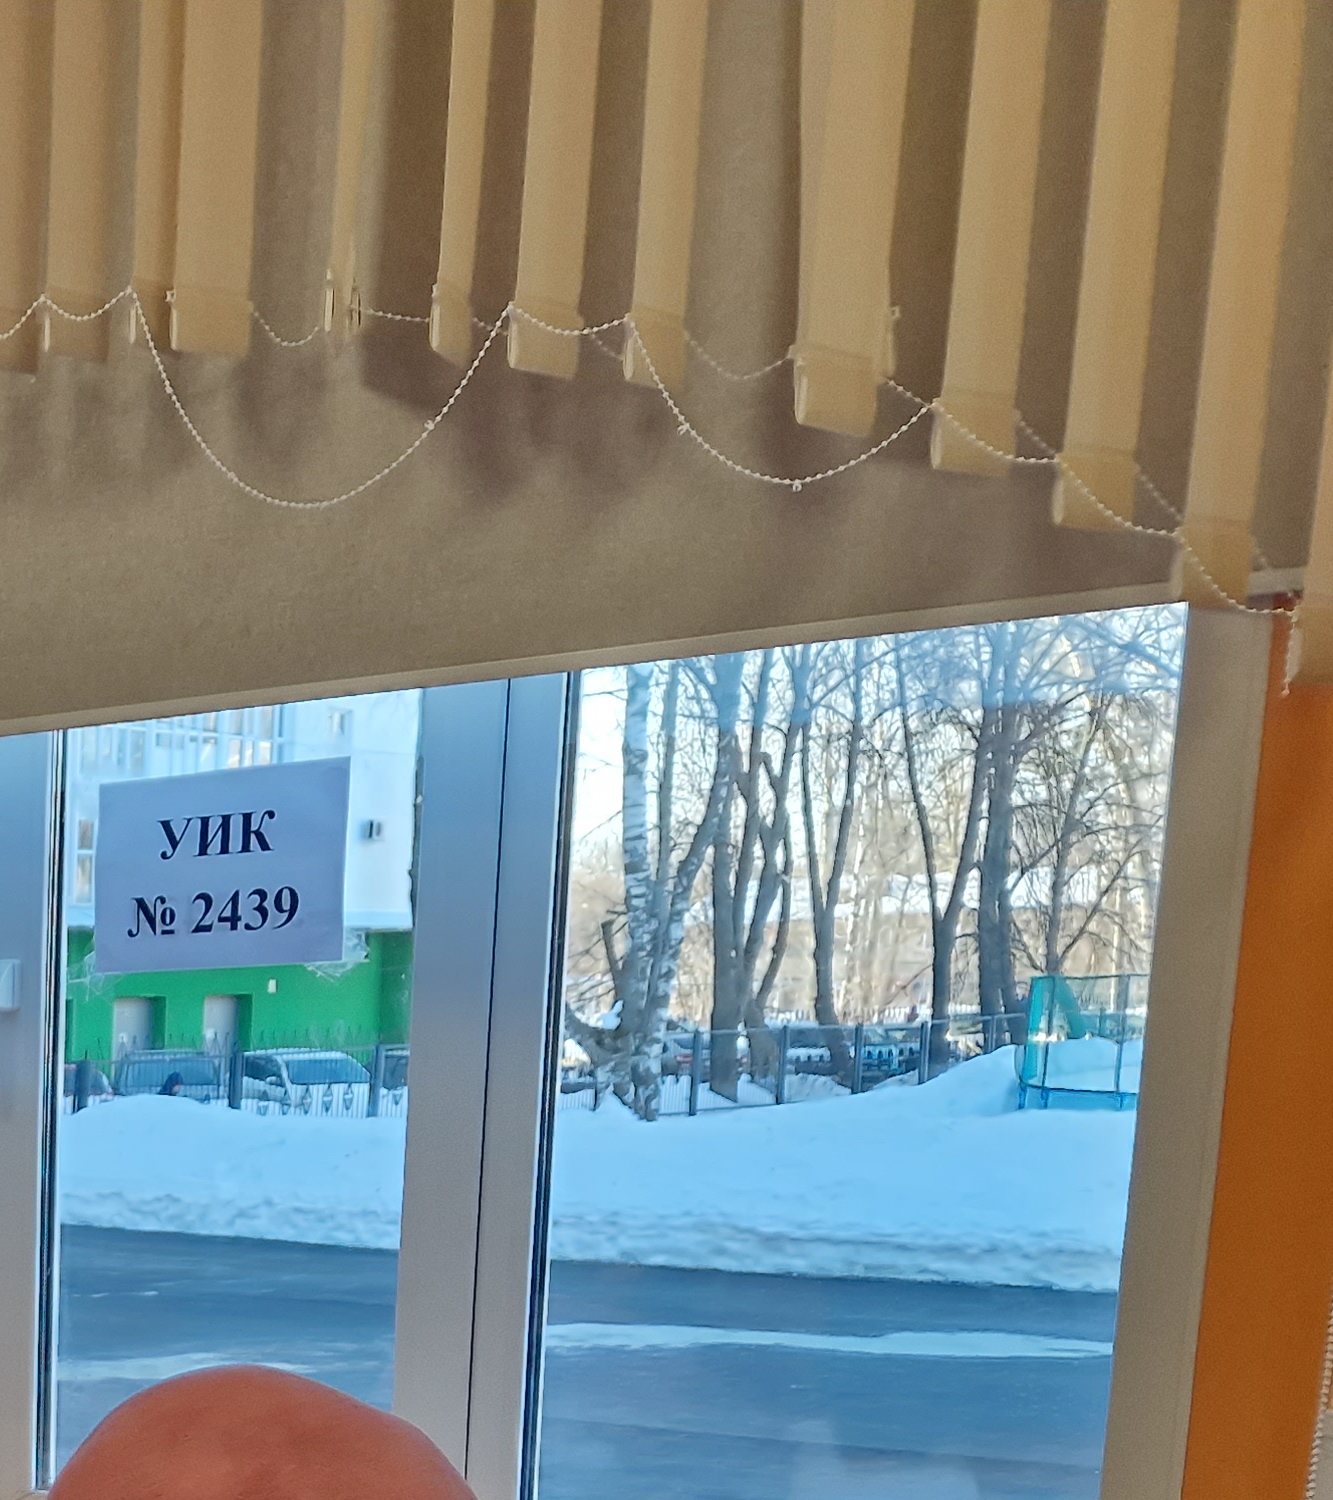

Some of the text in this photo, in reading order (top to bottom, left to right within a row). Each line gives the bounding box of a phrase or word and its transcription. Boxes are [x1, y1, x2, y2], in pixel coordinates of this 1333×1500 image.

[158, 809, 276, 860] УИК
[127, 886, 300, 938] № 2439
